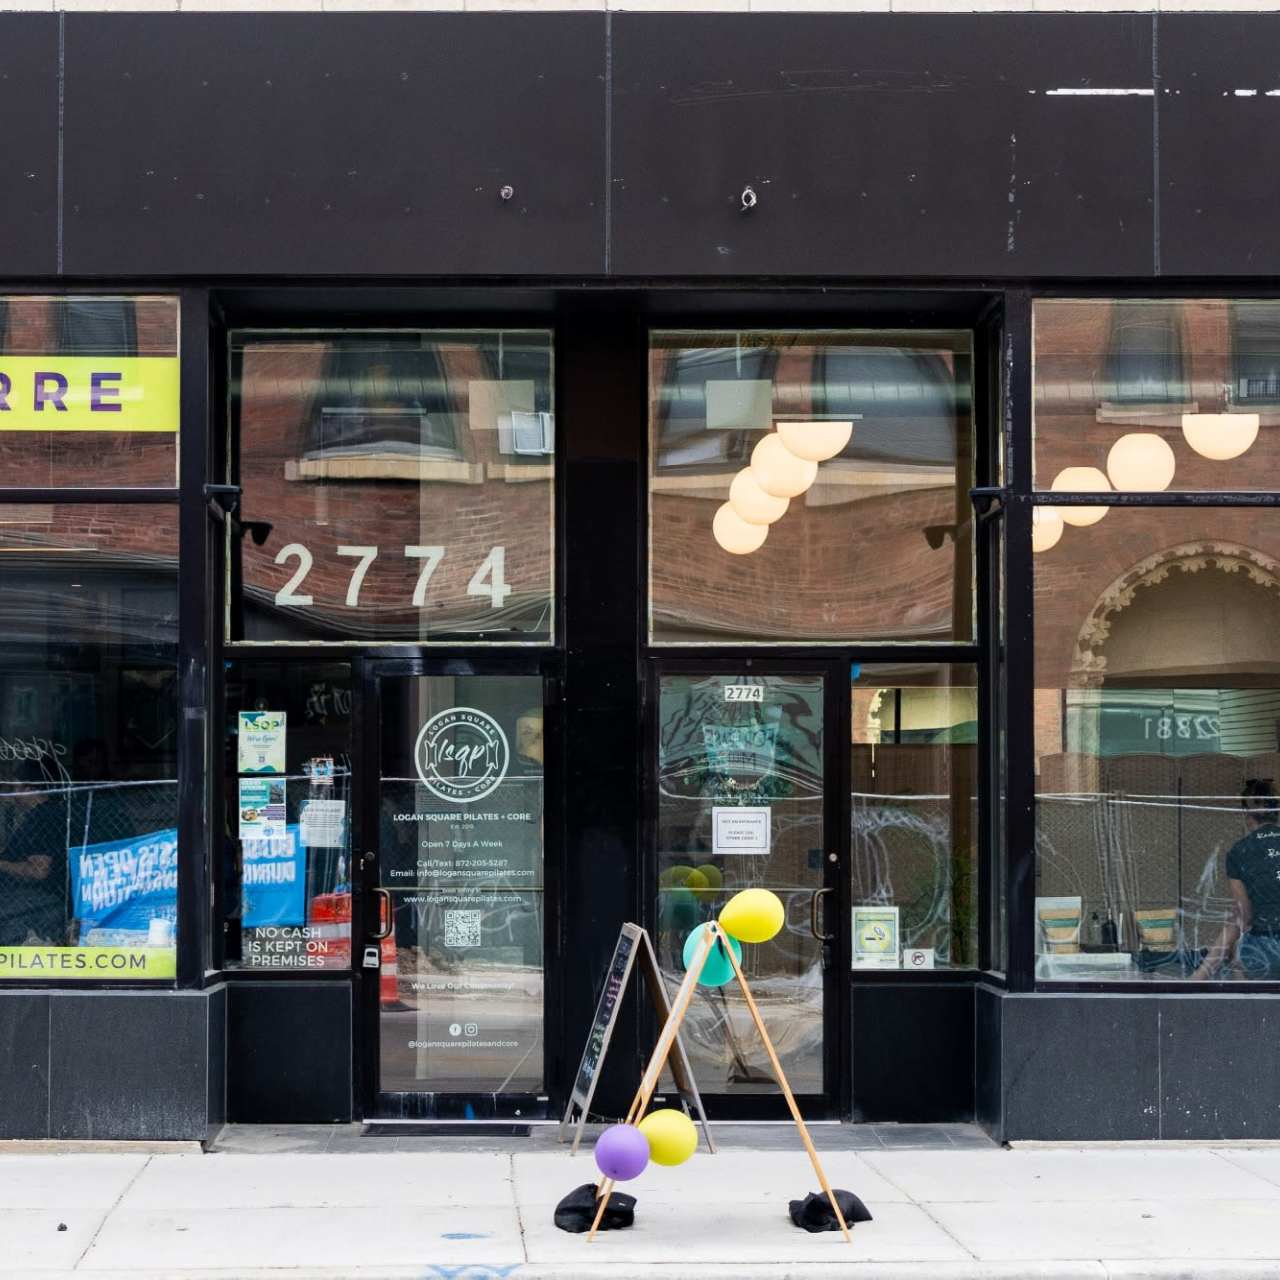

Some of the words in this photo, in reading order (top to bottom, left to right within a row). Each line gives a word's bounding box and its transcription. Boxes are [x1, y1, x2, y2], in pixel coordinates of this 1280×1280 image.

[273, 543, 513, 608] 2774
[726, 687, 761, 700] 2774
[429, 715, 457, 737] LOGAN
[461, 714, 496, 736] SQUARE
[429, 776, 464, 796] PILATES
[474, 775, 497, 793] CORE
[393, 813, 424, 821] LOGAN
[425, 813, 462, 822] SQUARE
[463, 813, 499, 821] PILATES
[507, 813, 531, 821] CORE
[421, 841, 443, 849] Open
[452, 841, 472, 850] Days
[417, 859, 454, 867] Call/Text:
[390, 869, 415, 877] Email:
[417, 869, 535, 878] info@logansquarepilates.com
[403, 895, 522, 903] www.logansquarepilates.com
[255, 927, 279, 939] NO
[281, 927, 321, 939] CASH
[248, 941, 261, 952] IS
[265, 941, 303, 952] KEPT
[306, 941, 328, 952] ON
[252, 955, 325, 966] PREMISES
[408, 1040, 519, 1049] @logansquarepilatesandcore
